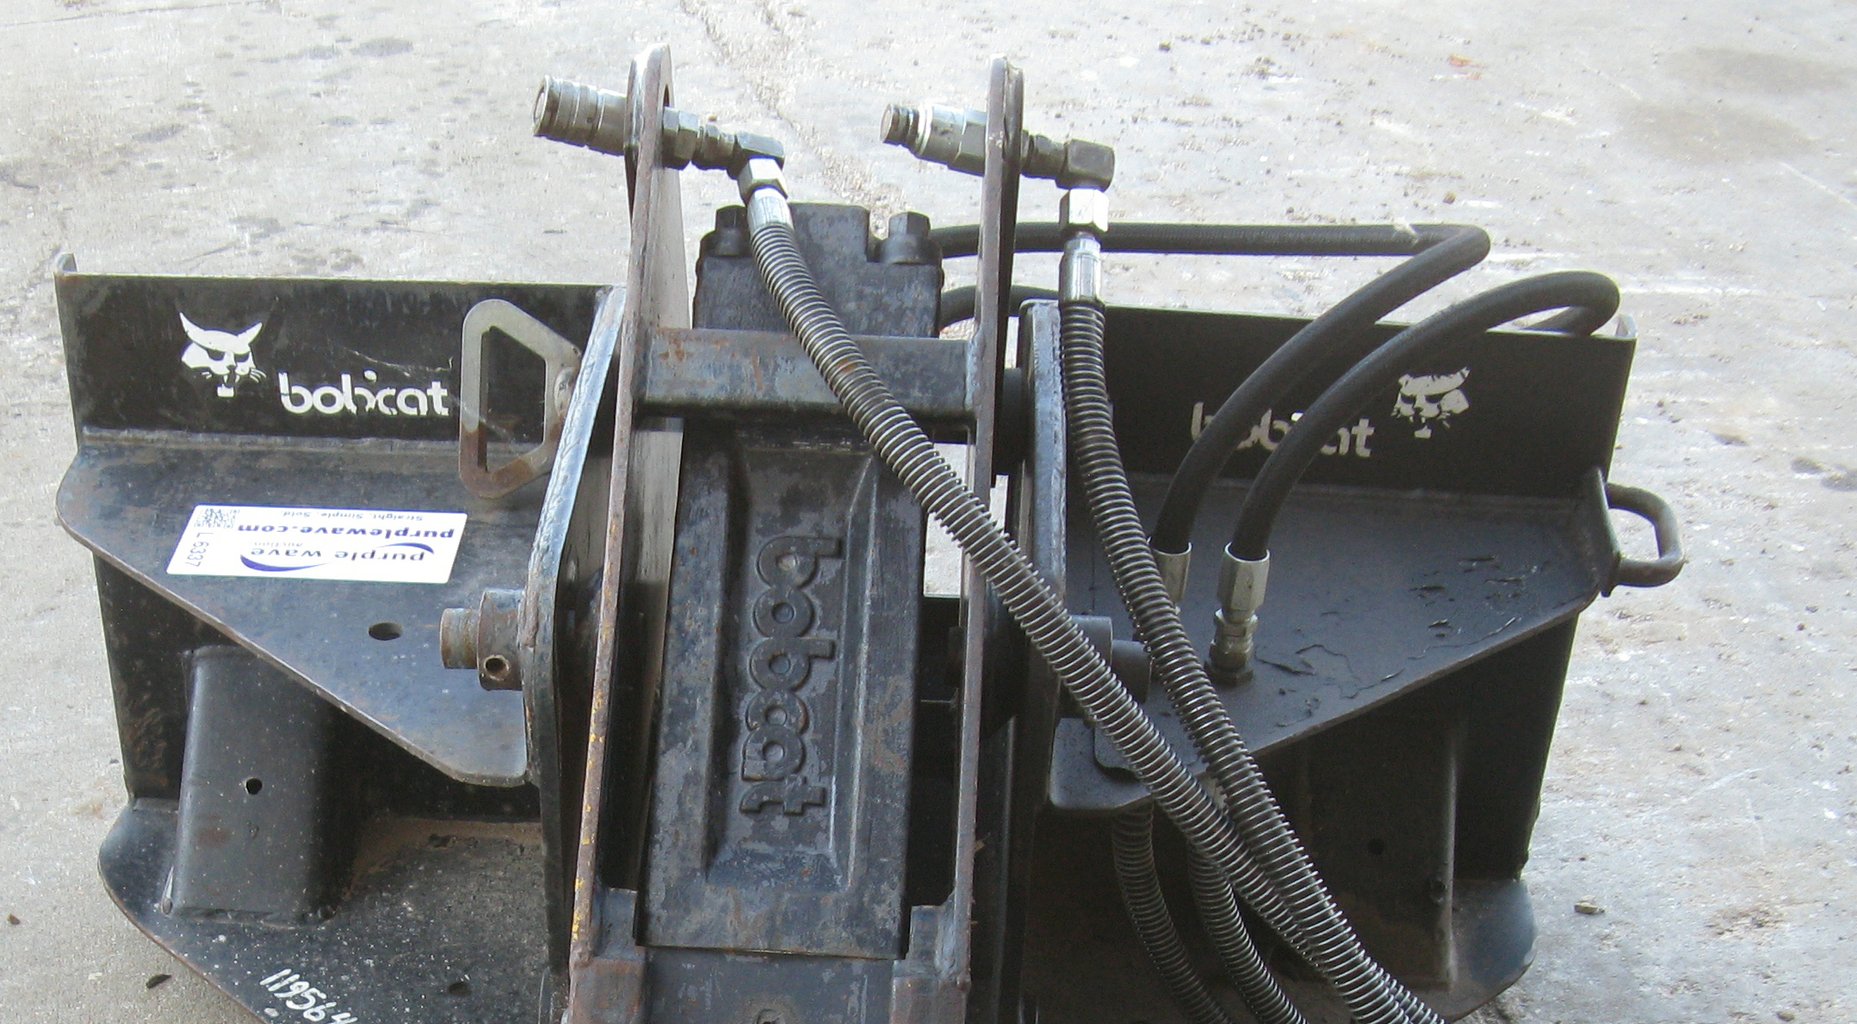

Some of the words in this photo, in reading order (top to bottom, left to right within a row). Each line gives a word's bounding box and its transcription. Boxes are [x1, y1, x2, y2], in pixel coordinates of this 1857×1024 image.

[278, 371, 450, 416] bobcat
[238, 525, 454, 538] purplewave.com
[250, 549, 321, 558] wave
[334, 550, 425, 562] purple
[741, 536, 842, 816] bobcat
